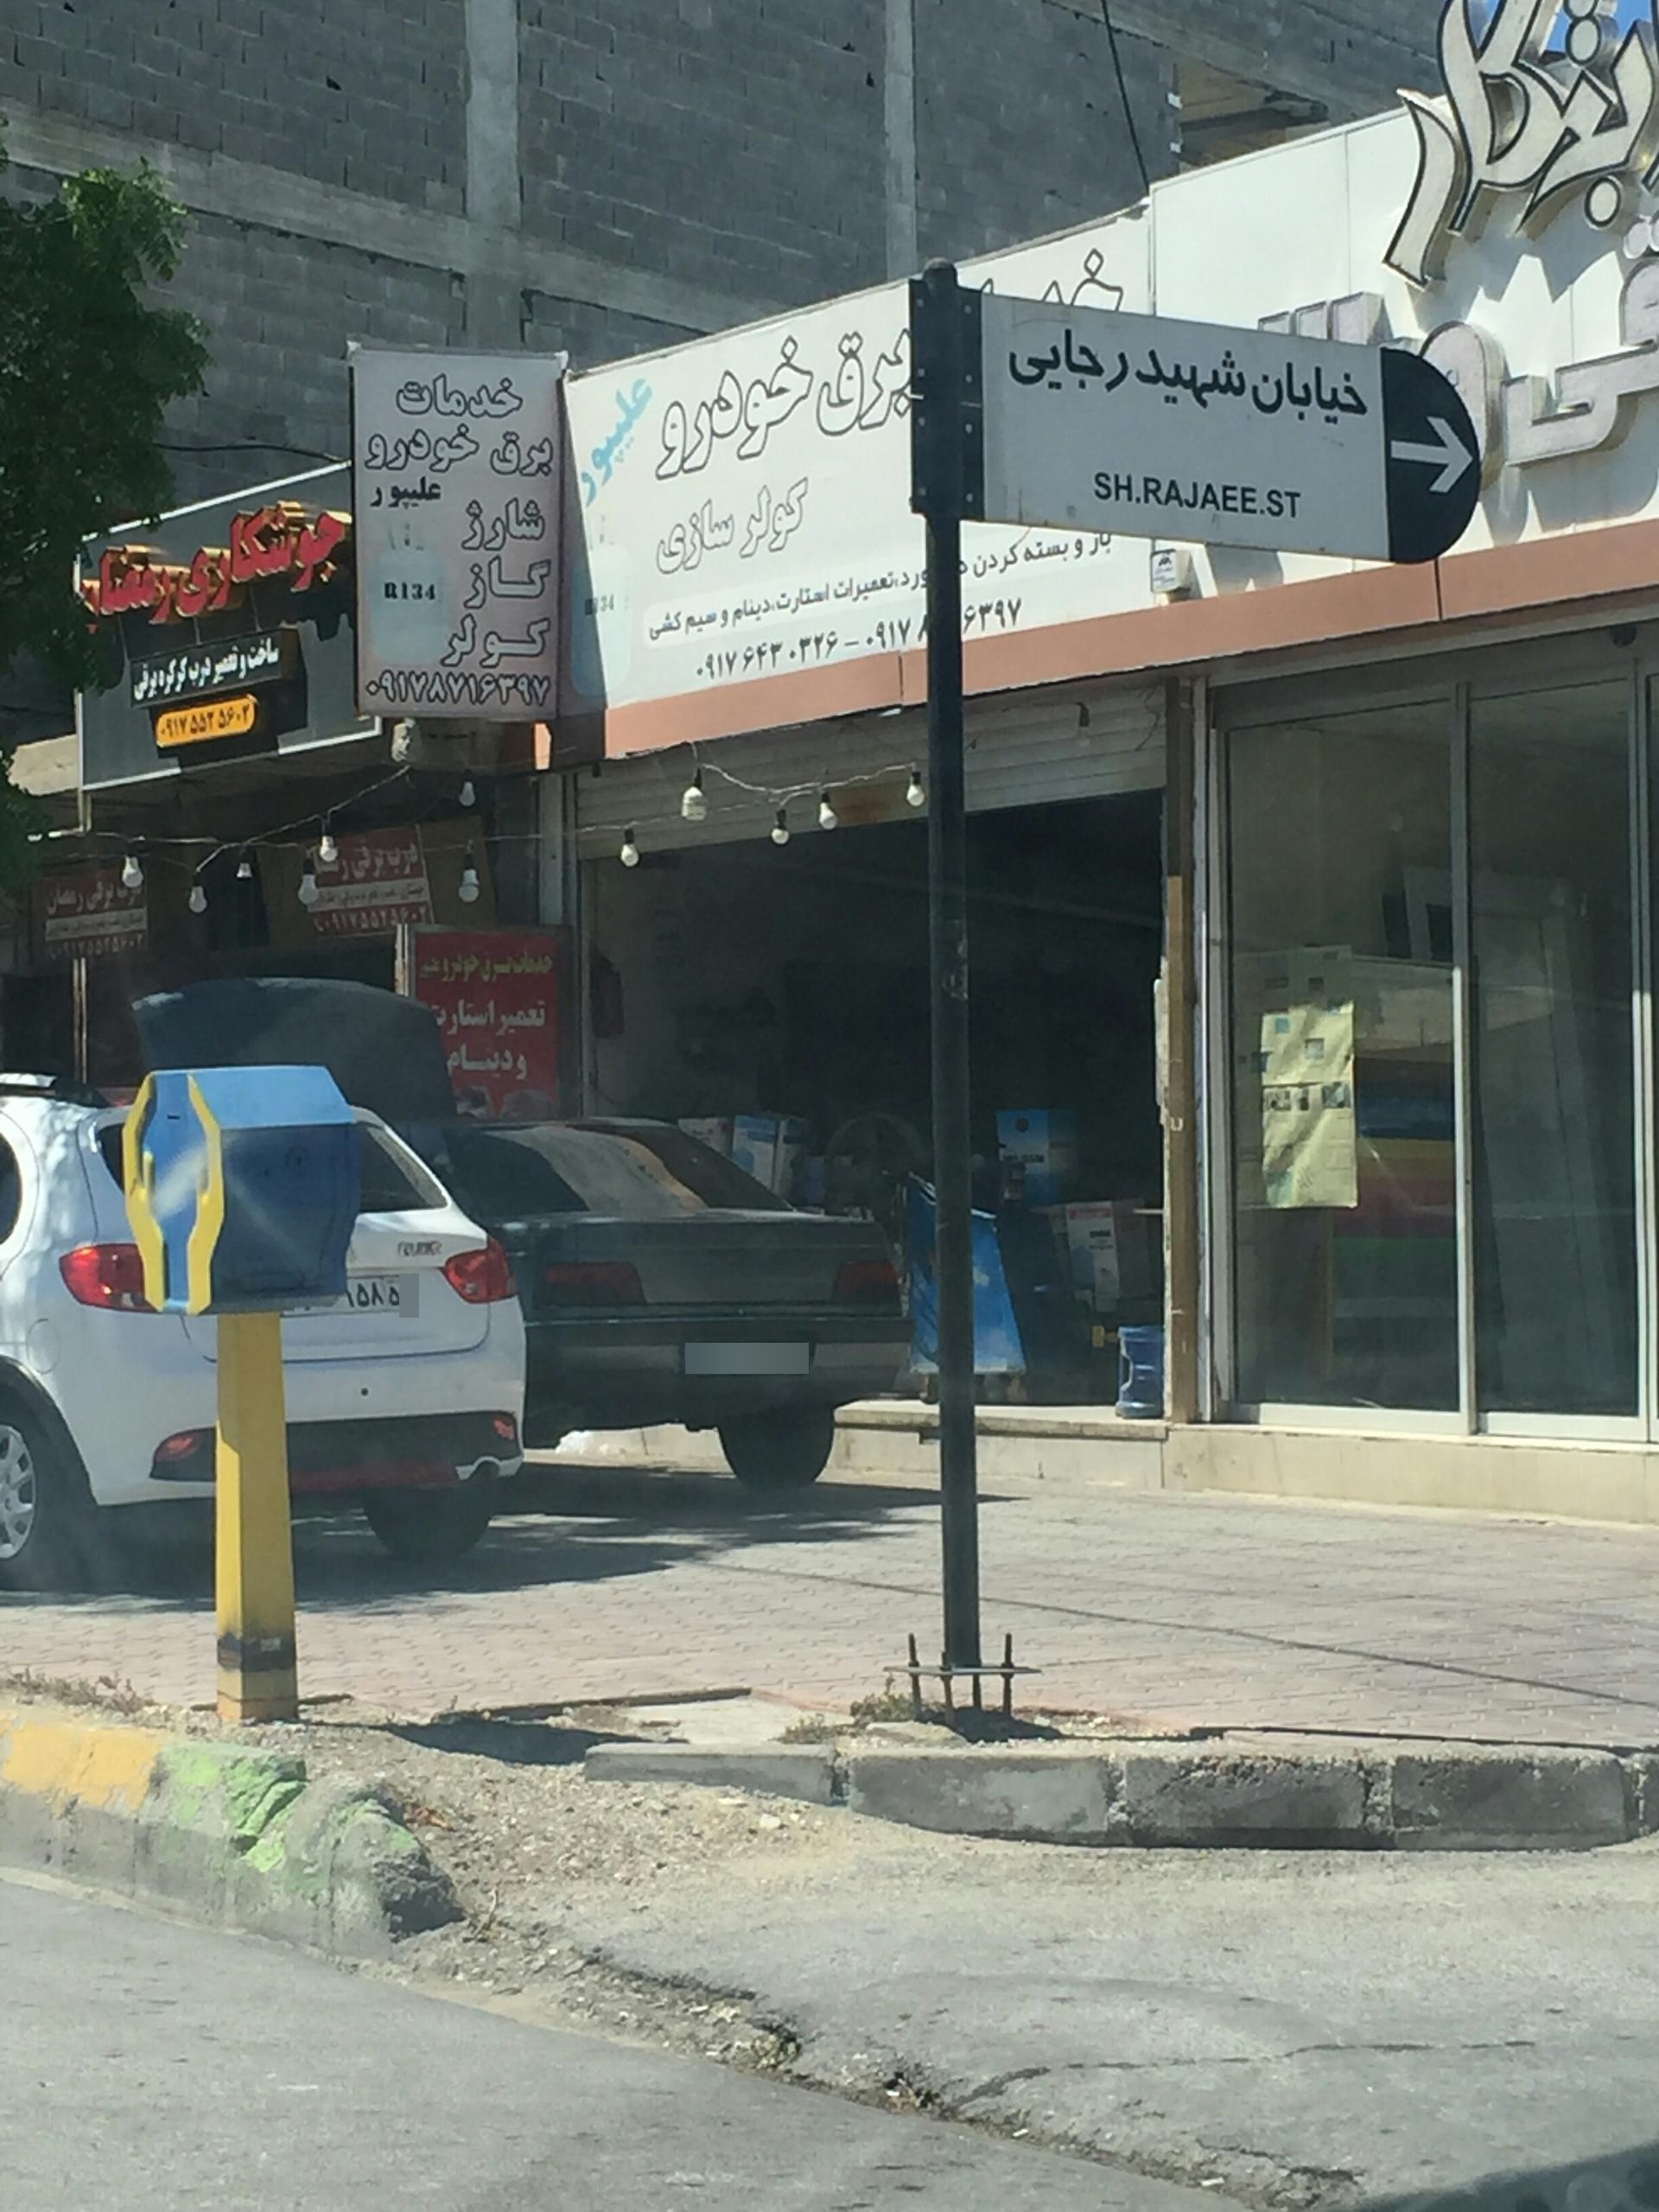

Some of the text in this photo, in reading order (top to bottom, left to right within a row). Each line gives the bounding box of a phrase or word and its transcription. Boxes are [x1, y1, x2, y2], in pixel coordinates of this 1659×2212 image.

[1008, 329, 1369, 425] خیابان شهید رجایی
[396, 373, 524, 418] خدمات
[655, 328, 911, 480] برق خودرو
[365, 423, 554, 476] برق خودرو
[370, 476, 442, 509] علیپور
[1093, 471, 1301, 518] SH.RAJAEE.ST
[461, 497, 545, 551] شارژ
[657, 476, 808, 575] کولر سازی
[973, 542, 1020, 578] کردن
[1024, 540, 1069, 562] بسته
[1074, 537, 1084, 559] و
[385, 582, 435, 600] R134
[463, 554, 552, 609] گاز
[834, 571, 893, 602] تعمیرات
[685, 612, 717, 635] سیم
[721, 609, 728, 628] و
[733, 599, 772, 627] دینام
[441, 613, 551, 669] کولر
[366, 670, 550, 706] ۰۹۱۷۸۷۱۶۳۹۷
[496, 1005, 546, 1036] تعمیر
